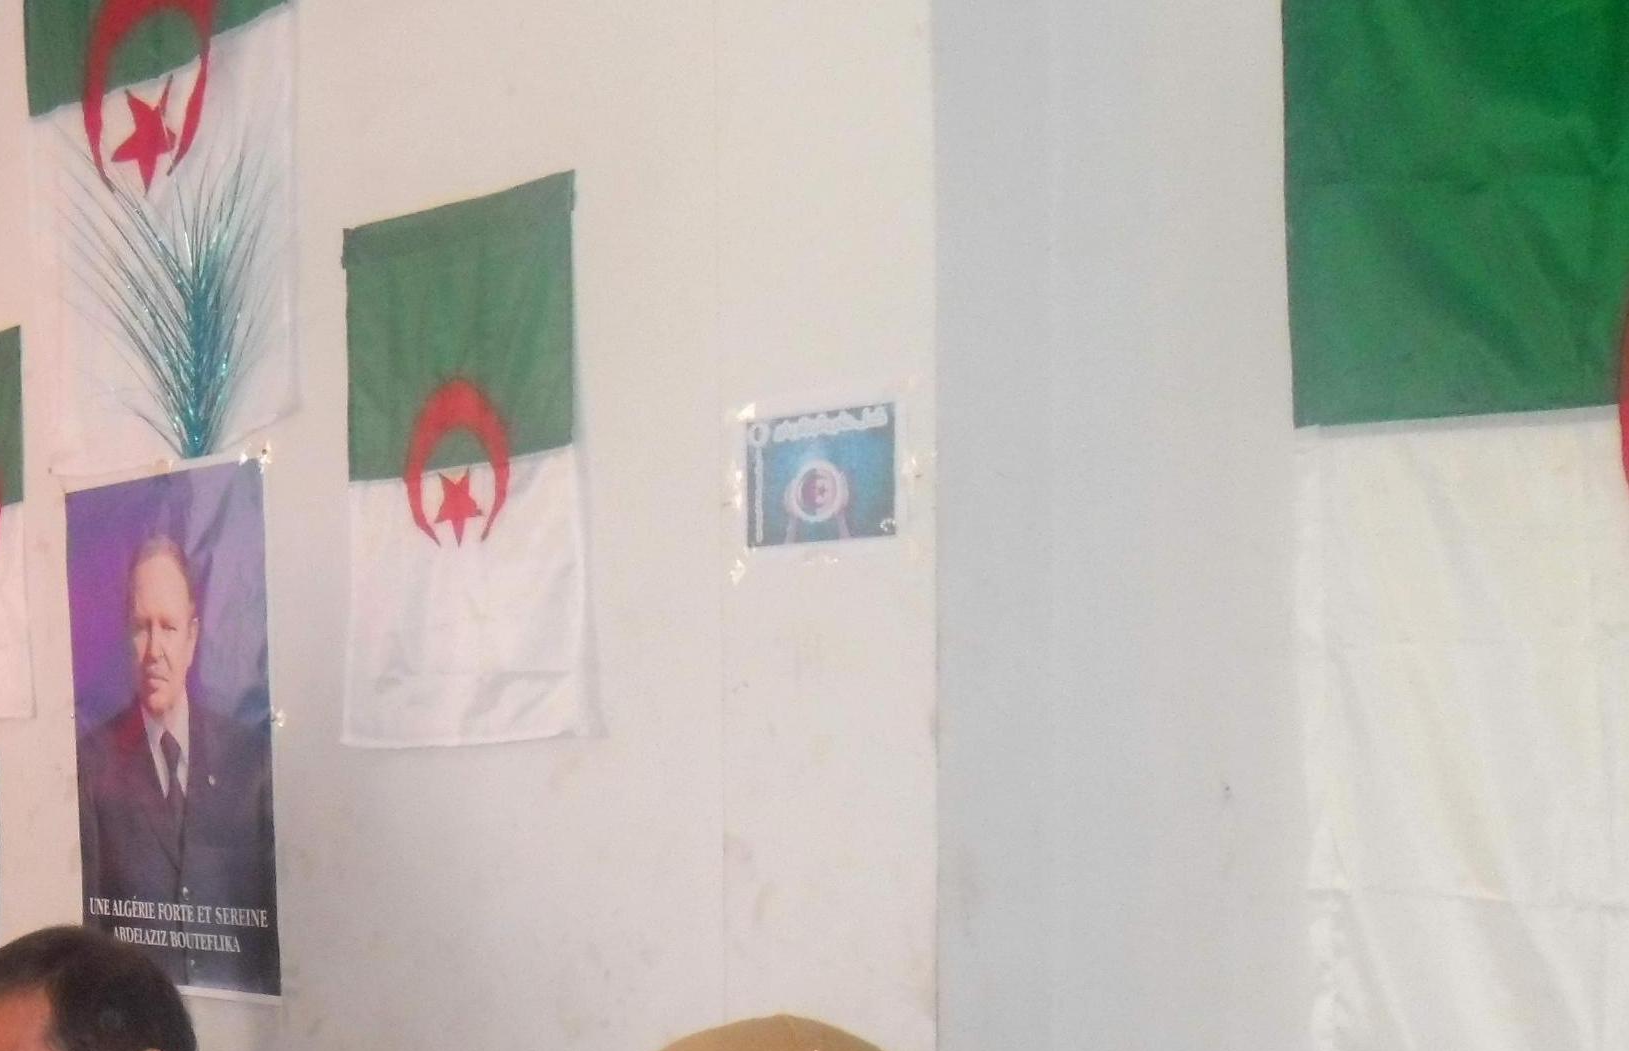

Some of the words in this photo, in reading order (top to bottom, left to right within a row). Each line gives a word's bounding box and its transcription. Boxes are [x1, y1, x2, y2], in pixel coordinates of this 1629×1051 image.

[89, 897, 111, 915] UNE
[158, 903, 195, 922] FORTE
[197, 905, 212, 924] ET
[215, 907, 269, 928] SEREINE
[171, 931, 241, 953] BOUTEFLIKA
